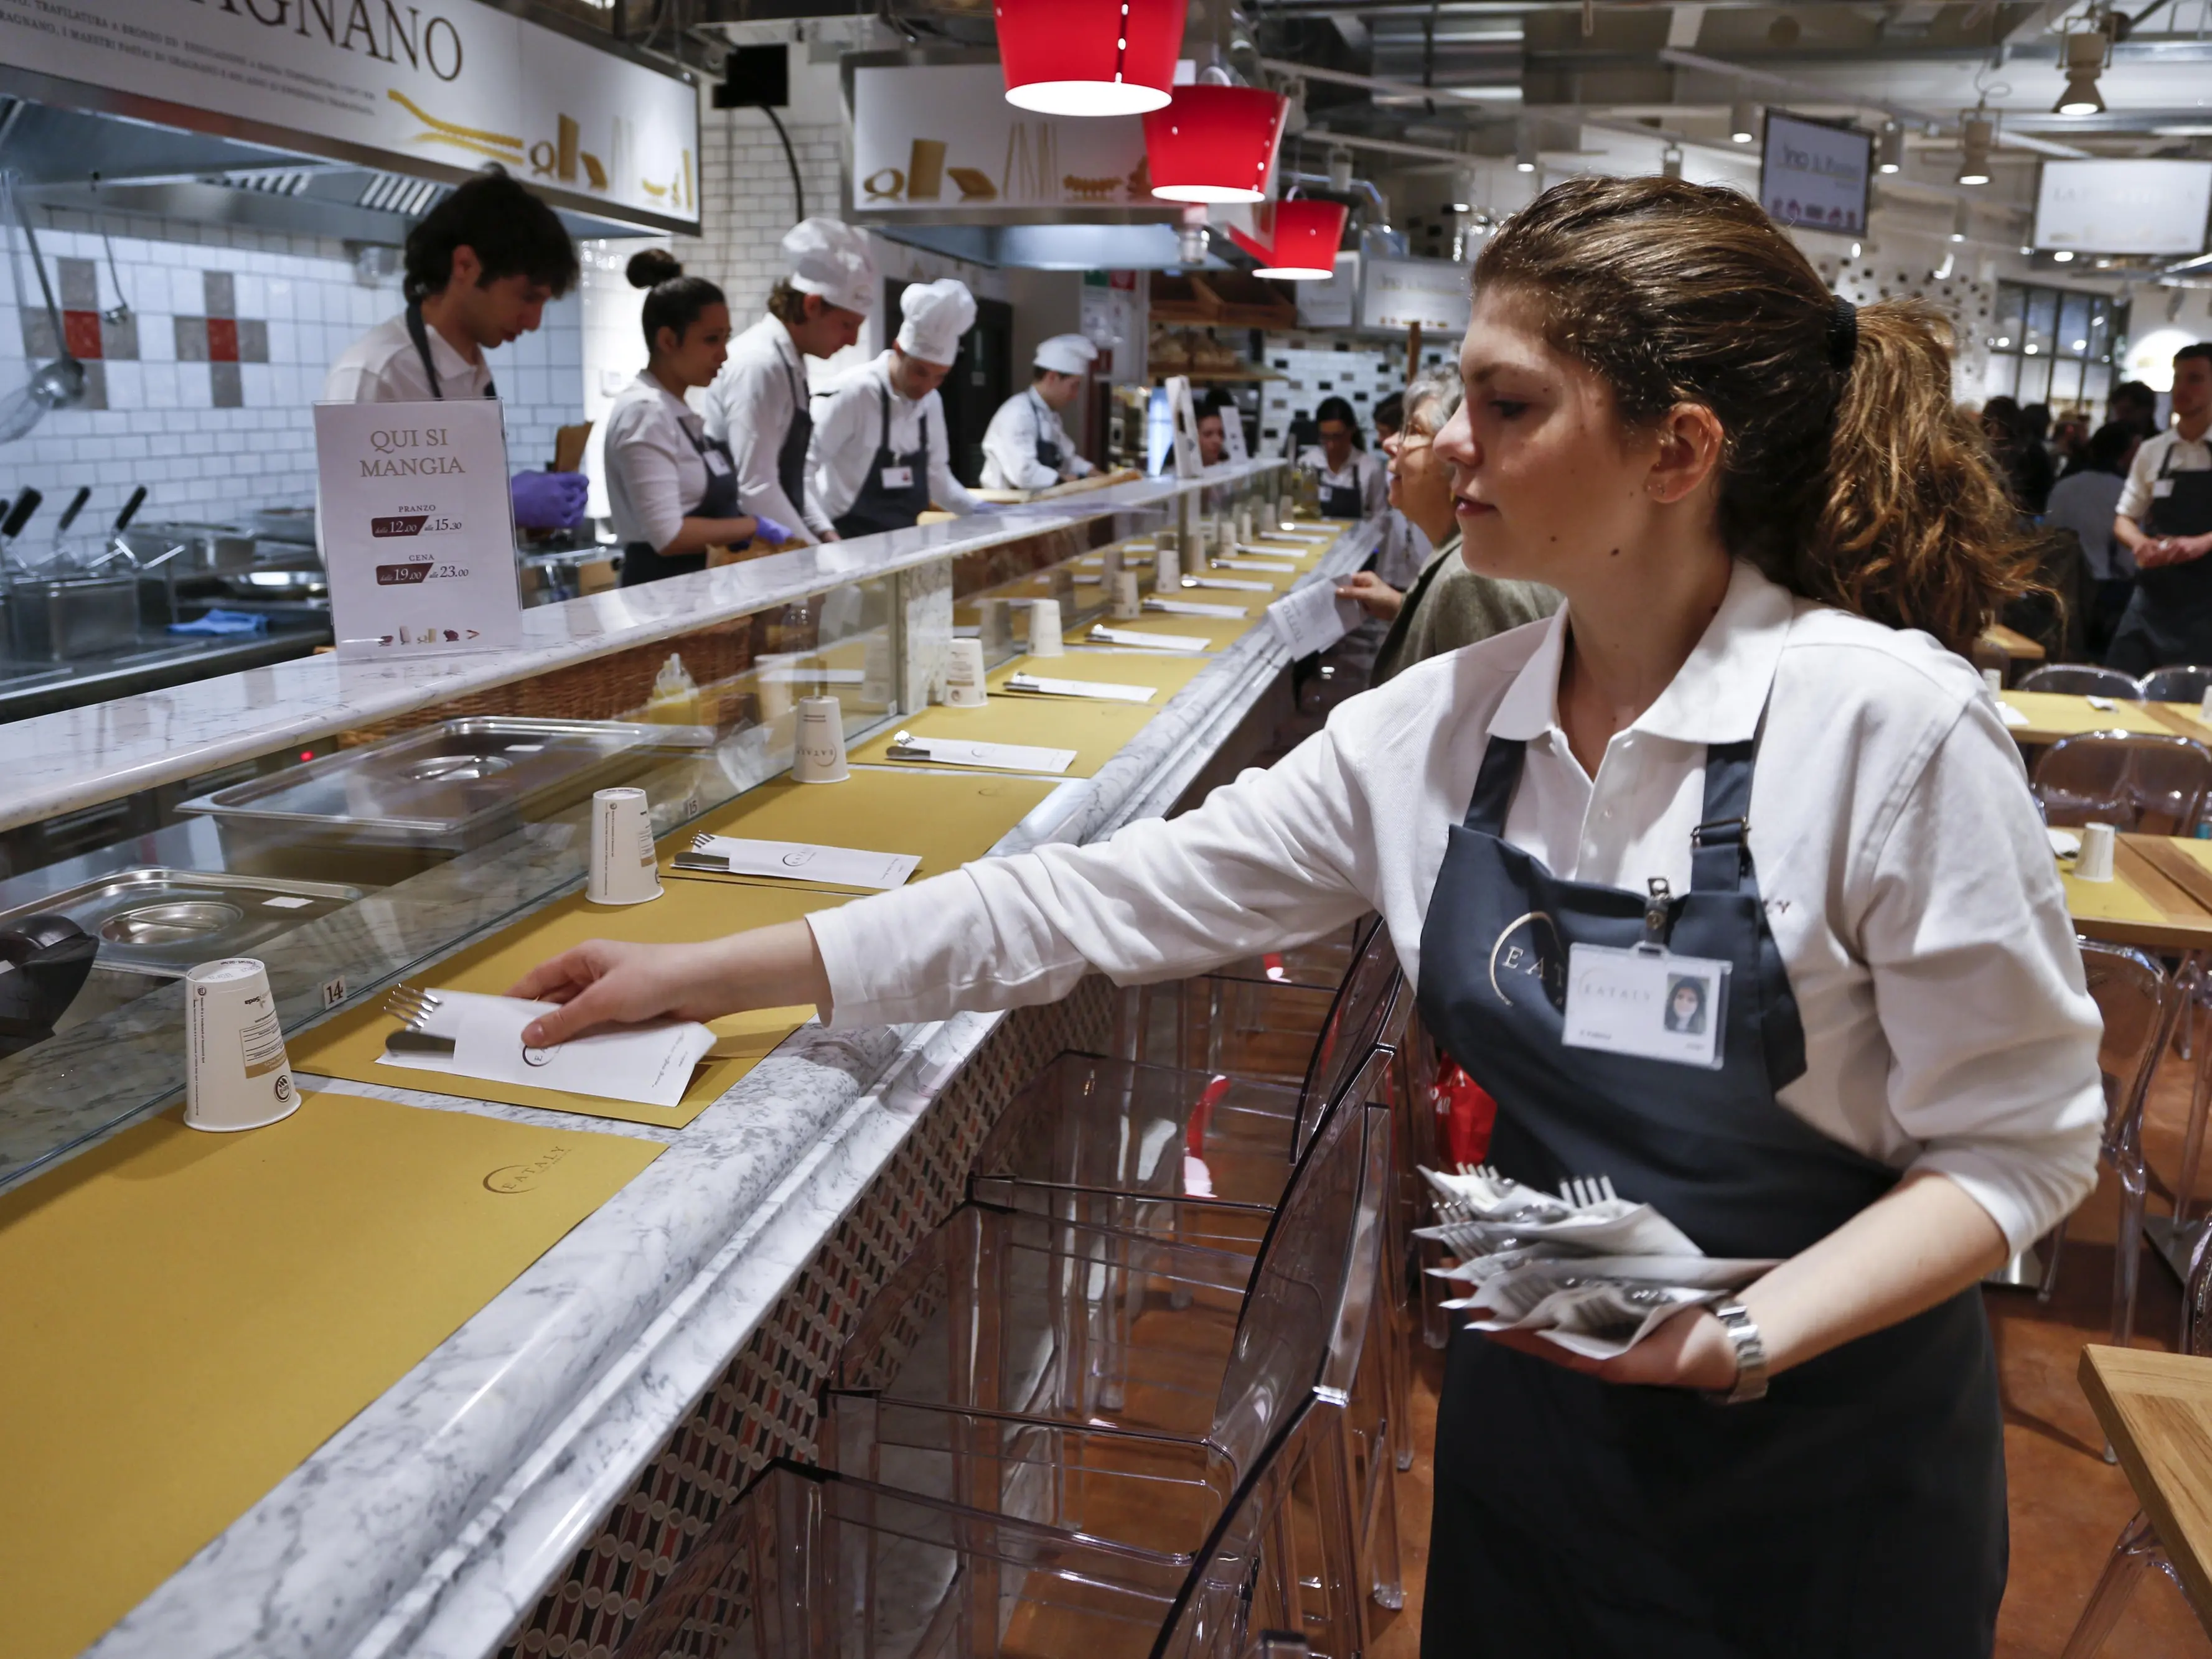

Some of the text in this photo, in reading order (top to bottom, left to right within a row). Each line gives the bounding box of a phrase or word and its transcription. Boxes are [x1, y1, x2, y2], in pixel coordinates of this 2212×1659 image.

[187, 0, 462, 82] GNANO
[370, 429, 448, 454] QUI SI
[360, 457, 466, 477] MANGIA
[398, 505, 436, 513] PRANZO
[390, 521, 417, 533] 12.00
[435, 518, 462, 531] 15.30
[395, 568, 422, 580] 19.00
[440, 566, 469, 578] 23.00
[689, 800, 698, 816] 15
[1502, 945, 1565, 988] EAT
[245, 996, 260, 1005] Seda
[326, 981, 344, 1004] 14
[501, 1146, 565, 1190] EATALY
